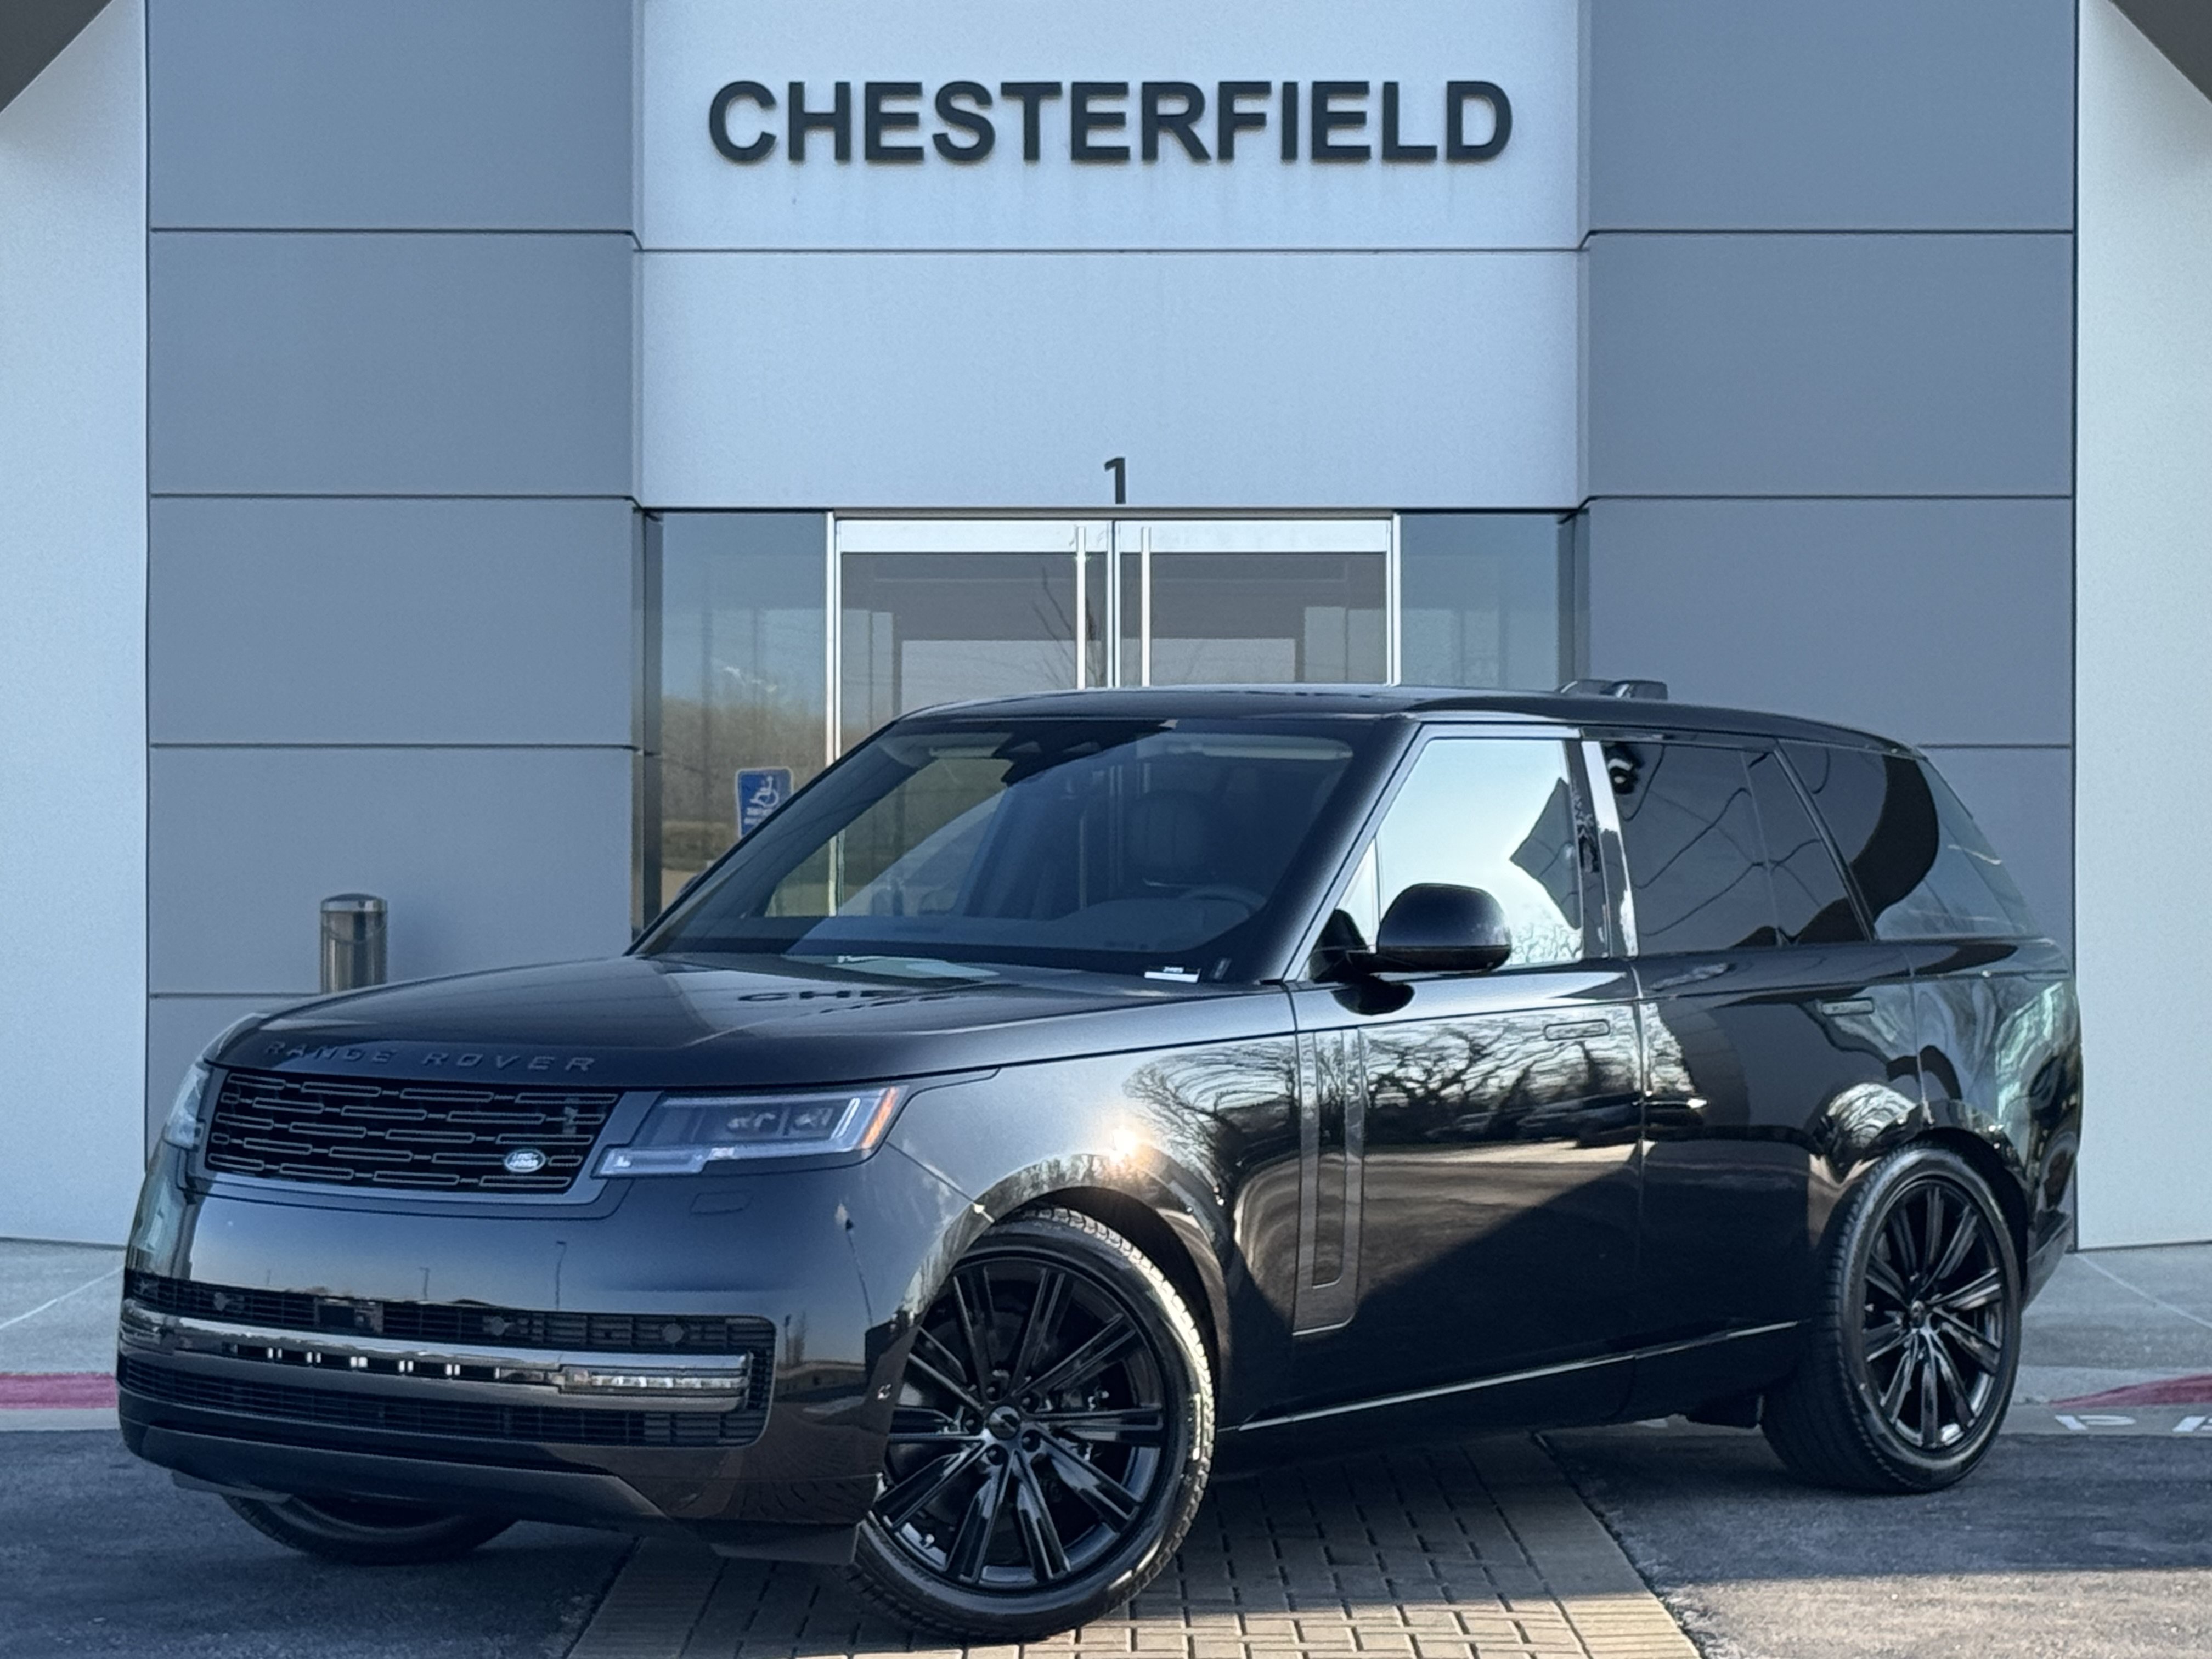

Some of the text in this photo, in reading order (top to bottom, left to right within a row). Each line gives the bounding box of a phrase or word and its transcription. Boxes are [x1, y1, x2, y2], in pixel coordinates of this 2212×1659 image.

[709, 81, 1513, 165] CHESTERFIELD
[1104, 457, 1126, 504] 1
[266, 1041, 596, 1071] RANGE ROVER
